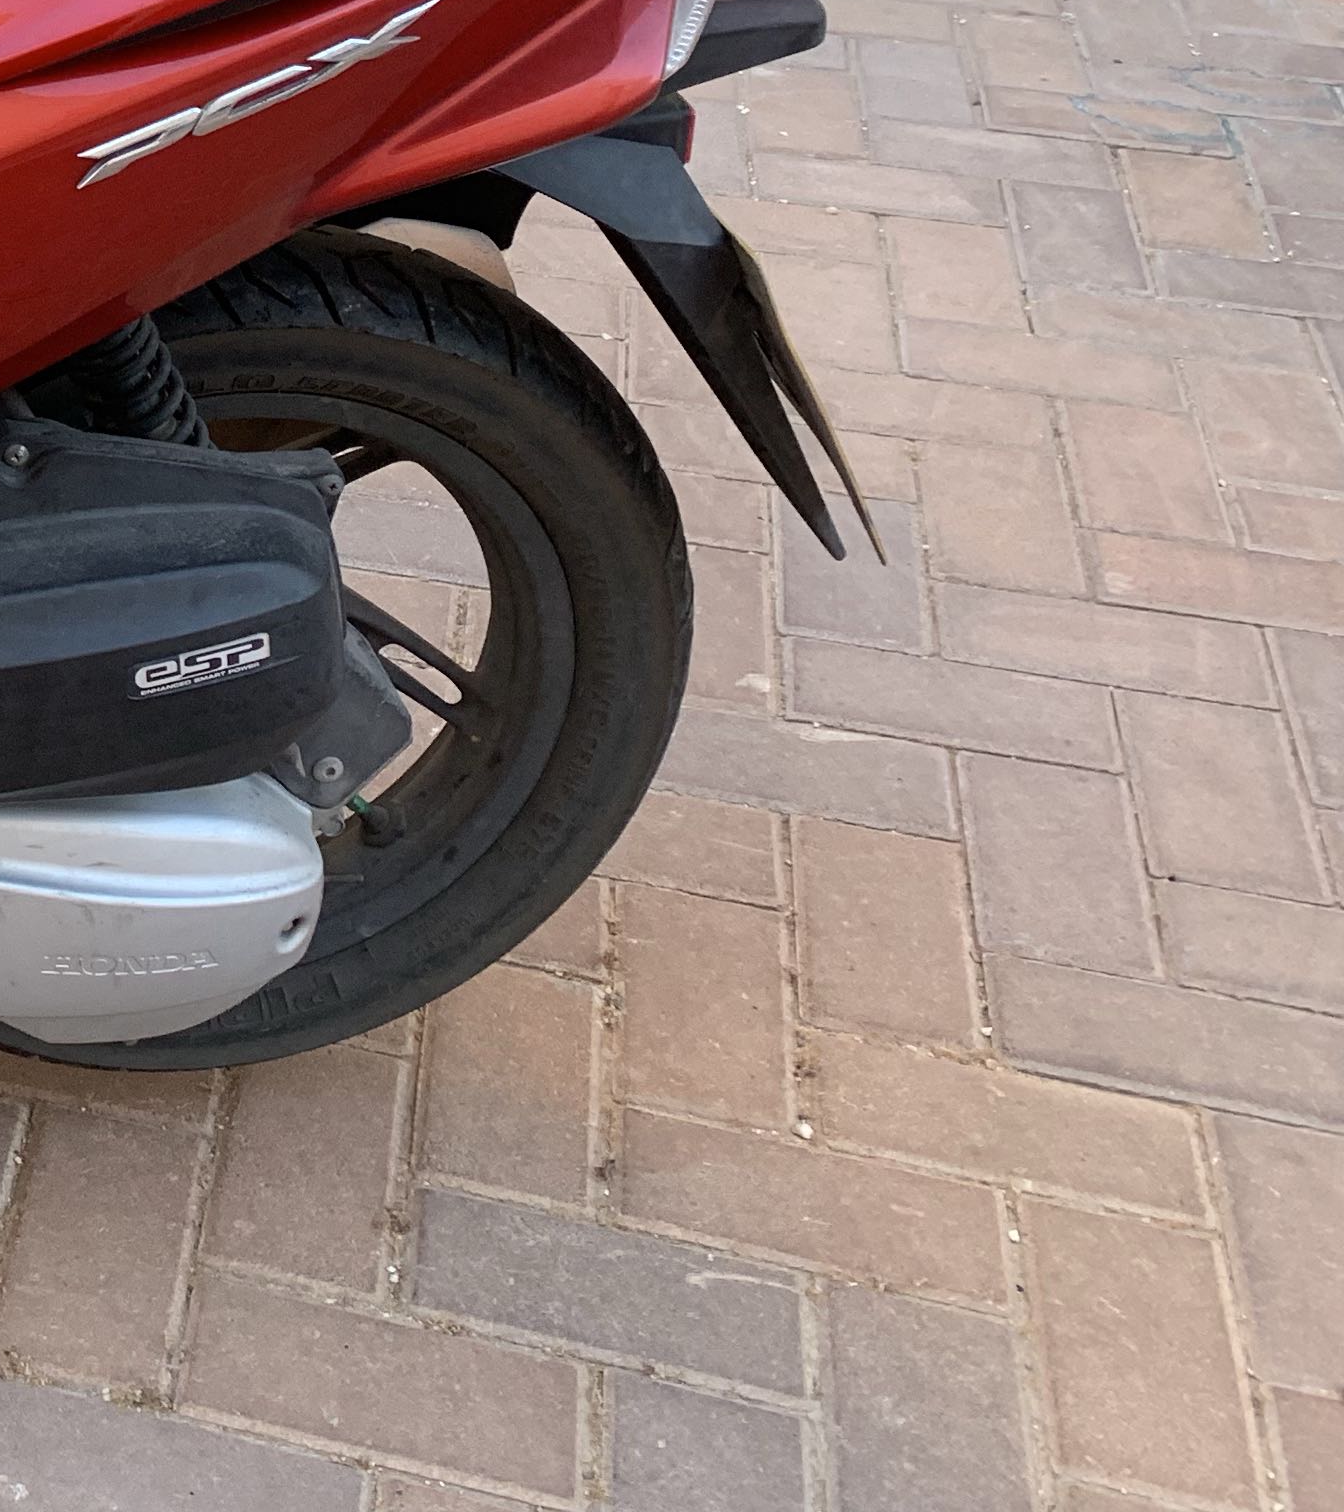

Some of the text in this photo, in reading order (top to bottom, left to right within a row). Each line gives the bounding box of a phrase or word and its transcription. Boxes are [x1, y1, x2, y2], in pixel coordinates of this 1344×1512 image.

[140, 661, 260, 696] ENHANCED SMART POWER
[40, 949, 220, 977] HONDA
